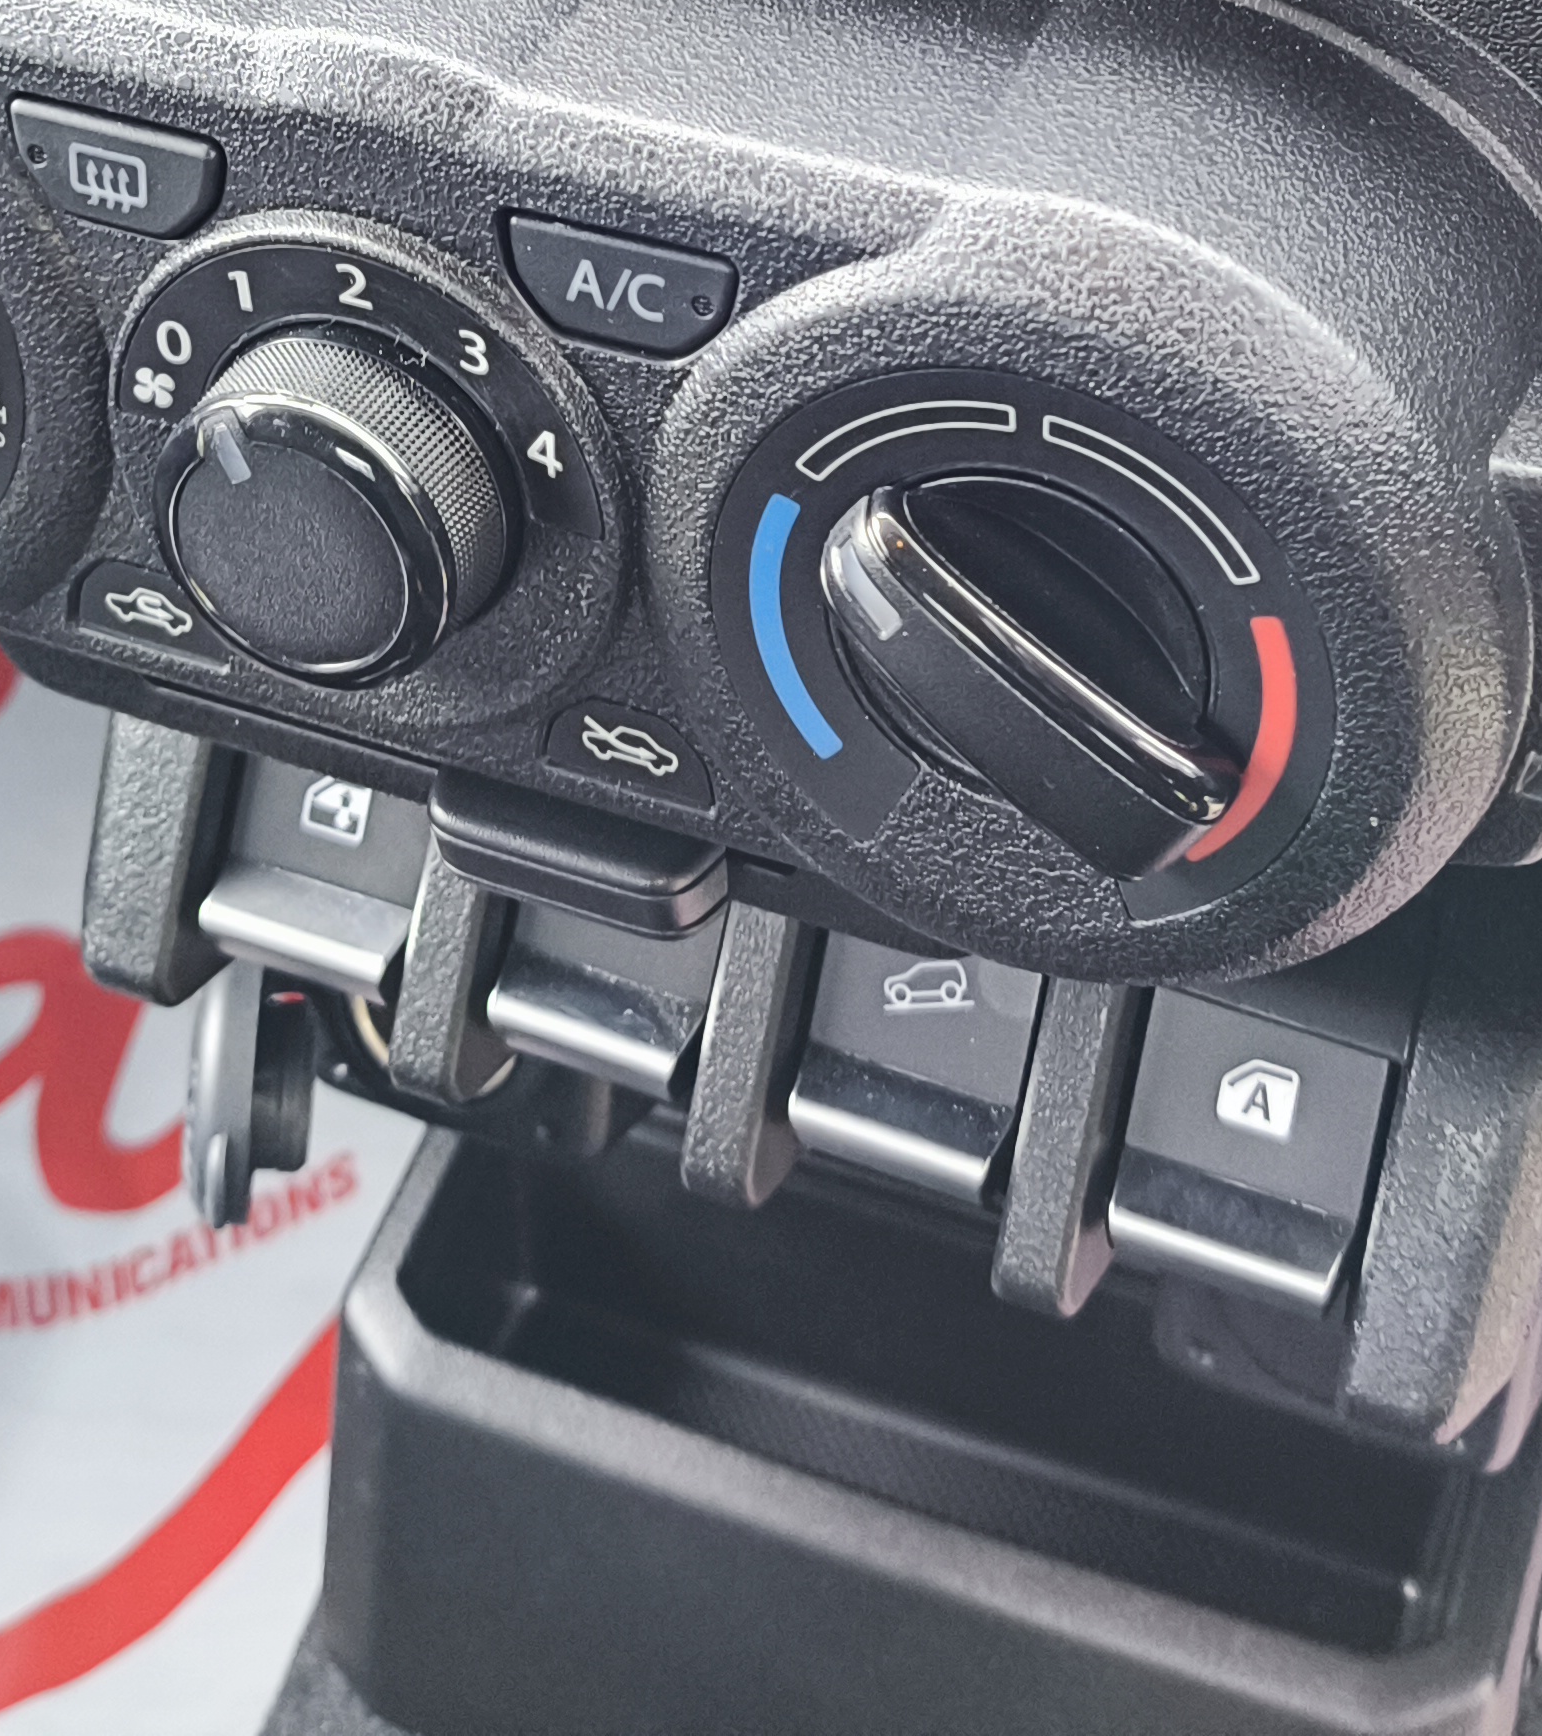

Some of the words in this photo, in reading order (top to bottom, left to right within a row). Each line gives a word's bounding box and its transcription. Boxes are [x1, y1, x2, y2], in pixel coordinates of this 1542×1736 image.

[565, 258, 666, 323] A/C
[156, 320, 192, 364] 0
[227, 270, 254, 312] 1
[335, 263, 374, 310] 2
[457, 329, 490, 376] 3
[527, 430, 564, 479] 4
[1242, 1081, 1270, 1122] A
